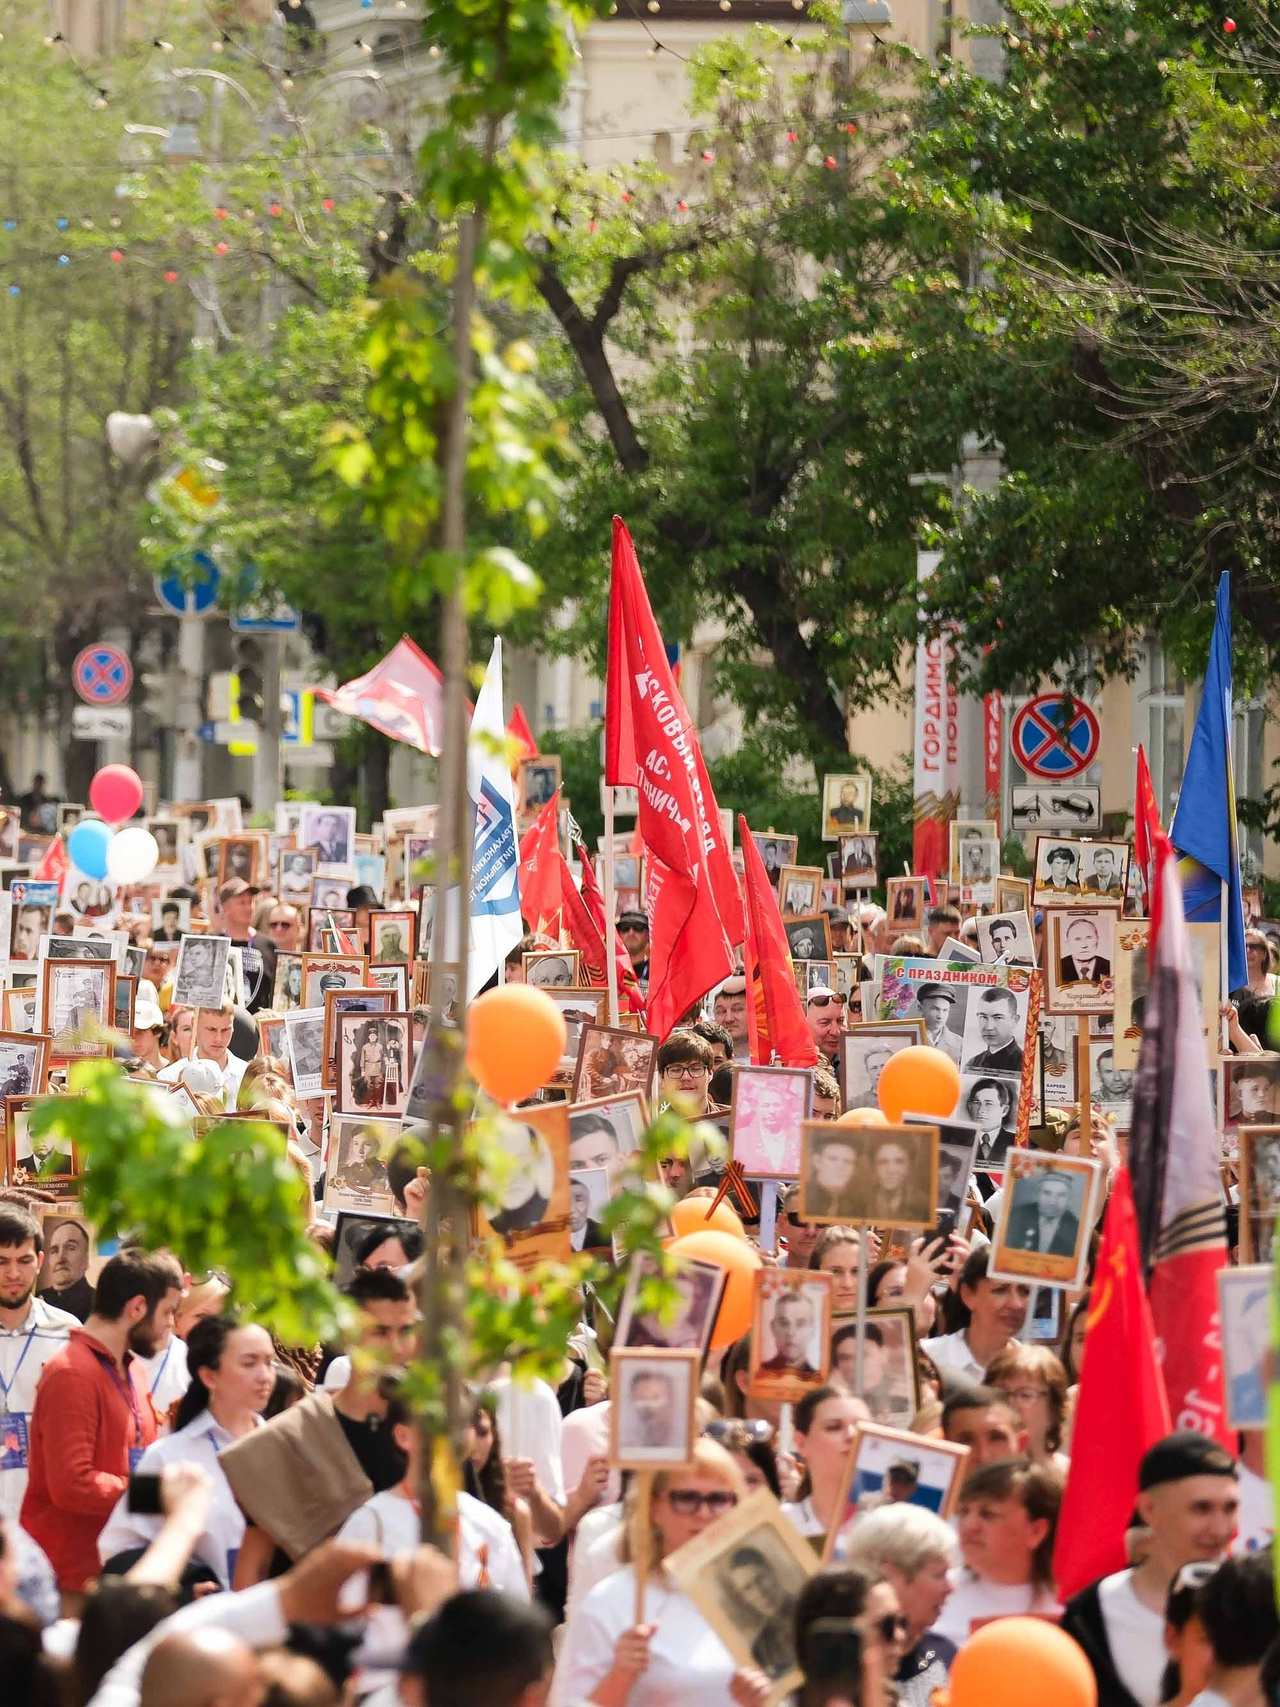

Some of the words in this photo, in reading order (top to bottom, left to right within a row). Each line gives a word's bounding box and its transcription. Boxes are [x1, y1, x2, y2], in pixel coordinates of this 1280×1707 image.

[923, 638, 942, 773] ГОРДИМС
[896, 967, 905, 978] С
[908, 969, 998, 984] ПРАЗДНИКОМ
